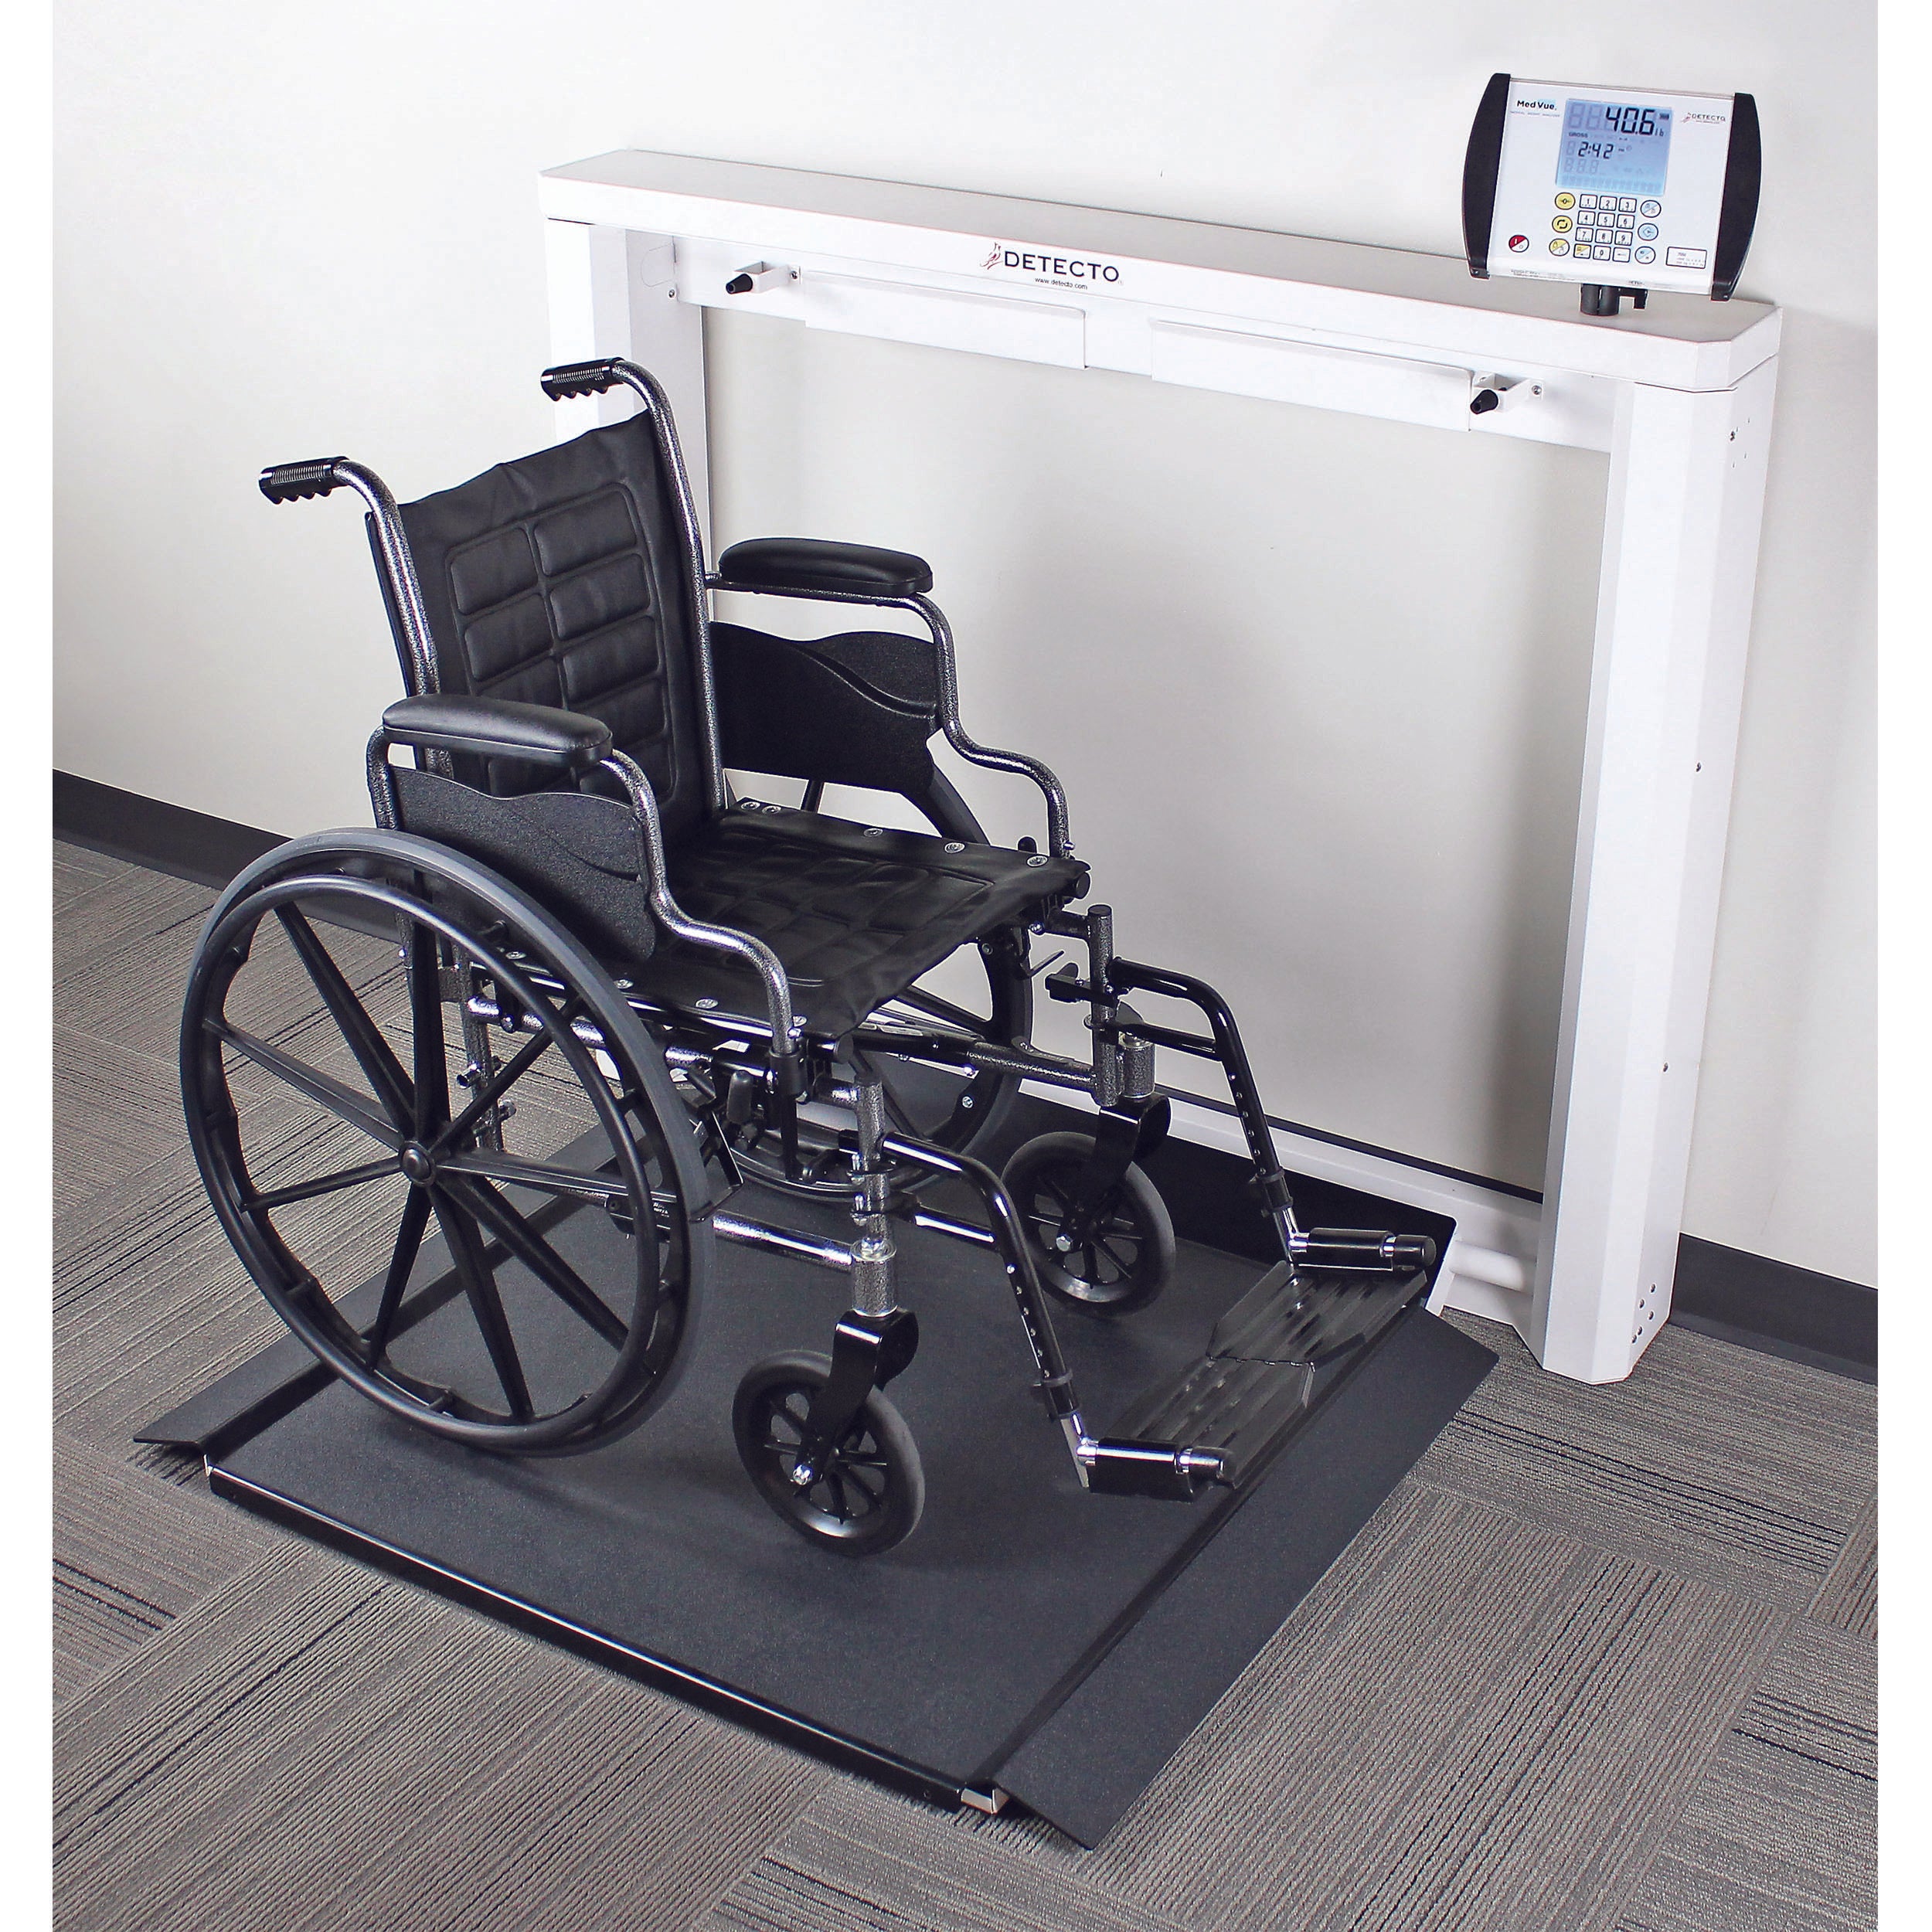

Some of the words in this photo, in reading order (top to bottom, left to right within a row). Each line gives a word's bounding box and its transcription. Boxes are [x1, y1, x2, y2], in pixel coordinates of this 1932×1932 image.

[1605, 107, 1655, 135] 40.6
[1577, 141, 1614, 159] 2:42
[1005, 251, 1119, 282] DETECTO
